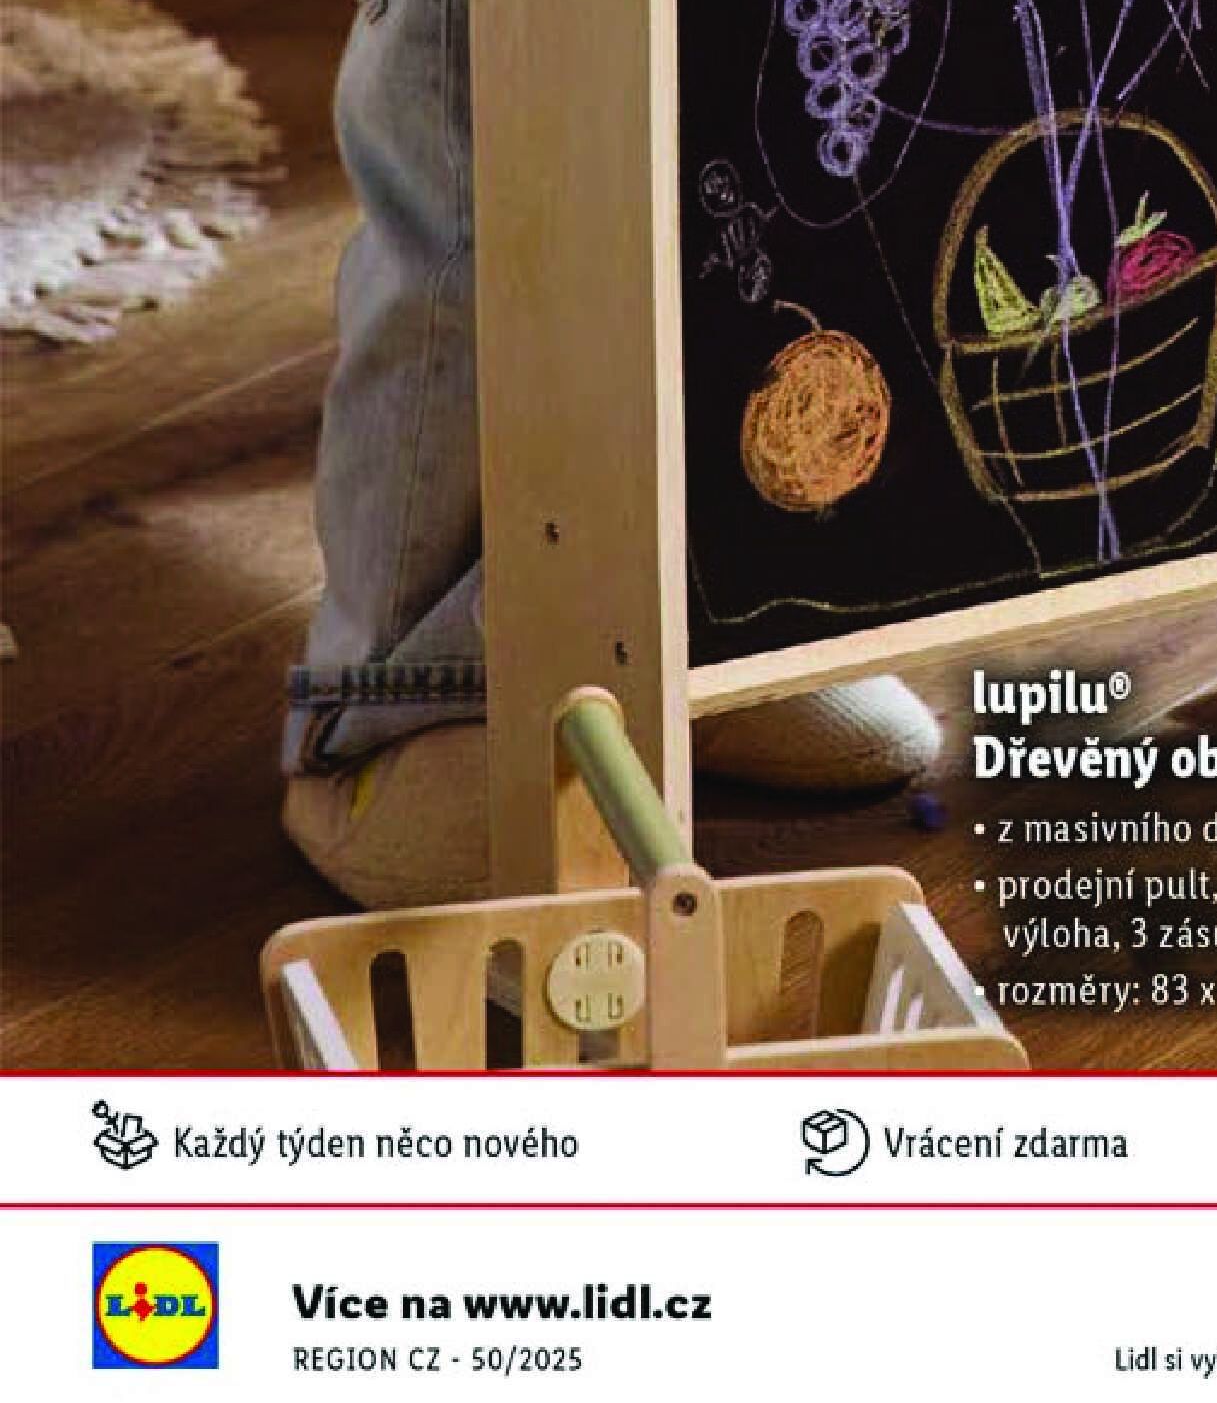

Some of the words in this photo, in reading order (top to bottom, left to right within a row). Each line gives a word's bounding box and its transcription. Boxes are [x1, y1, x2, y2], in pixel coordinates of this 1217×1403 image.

[973, 736, 1158, 789] Dřevěný
[998, 821, 1013, 842] z
[1024, 811, 1192, 842] masivního
[998, 869, 1134, 907] prodejní
[1144, 869, 1217, 907] pult,
[1004, 917, 1120, 955] výloha,
[1132, 917, 1146, 948] 3
[999, 974, 1139, 1013] rozměry:
[1151, 973, 1187, 1003] 83
[1200, 982, 1214, 1003] x
[175, 1127, 266, 1166] Každý
[279, 1127, 365, 1167] týden
[375, 1127, 452, 1158] něco
[464, 1127, 577, 1158] nového
[884, 1127, 1004, 1158] Vrácení
[1014, 1127, 1129, 1158] zdarma
[104, 1282, 206, 1321] LIDL
[292, 1283, 389, 1319] Více
[402, 1296, 452, 1319] na
[462, 1283, 712, 1319] www.lidl.cz
[293, 1346, 396, 1372] REGION
[409, 1346, 440, 1372] CZ
[472, 1346, 582, 1376] 50/2025
[1115, 1346, 1156, 1372] Lidl
[1166, 1346, 1182, 1372] si
